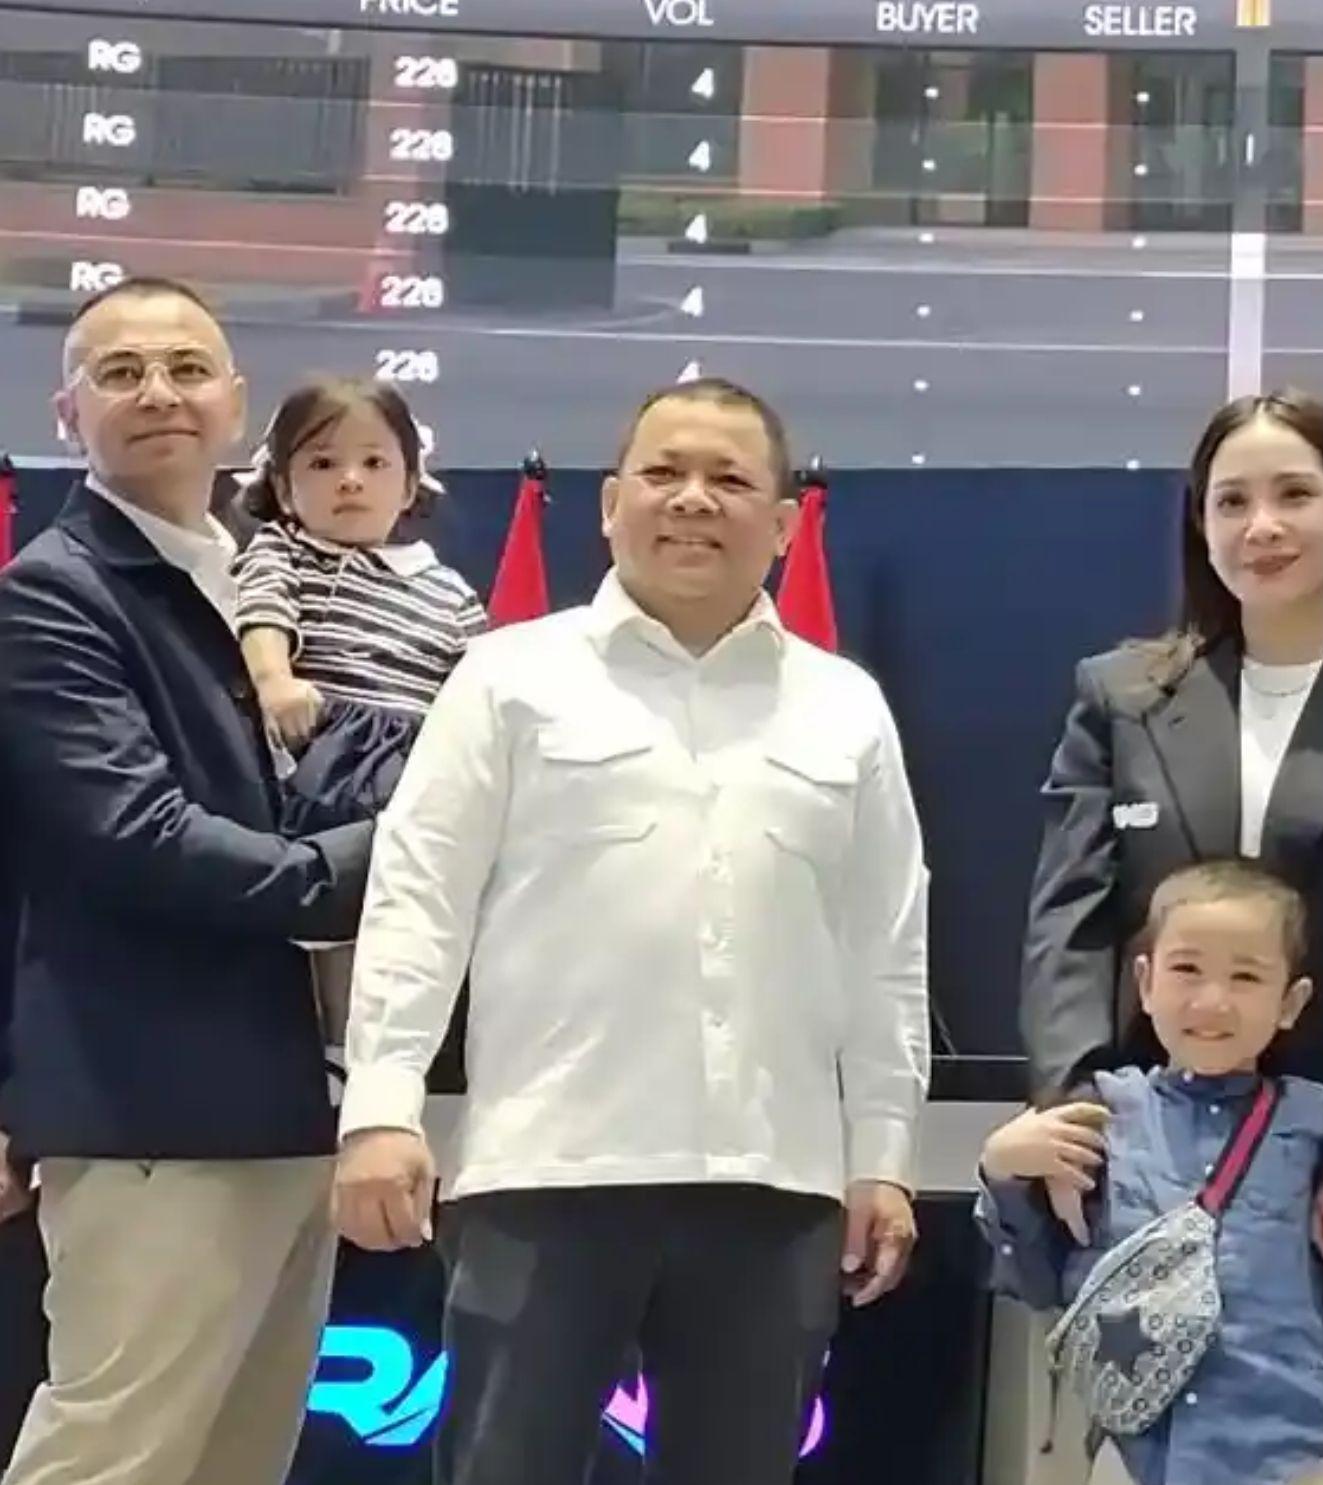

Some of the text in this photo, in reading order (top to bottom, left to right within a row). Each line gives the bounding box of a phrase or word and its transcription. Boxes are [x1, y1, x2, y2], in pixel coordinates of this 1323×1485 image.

[644, 0, 714, 26] VOL
[876, 1, 979, 33] BUYER
[1084, 5, 1197, 36] SELLER
[88, 39, 142, 73] RG
[83, 112, 136, 146] RG
[76, 186, 131, 220] RG
[70, 261, 123, 291] RG
